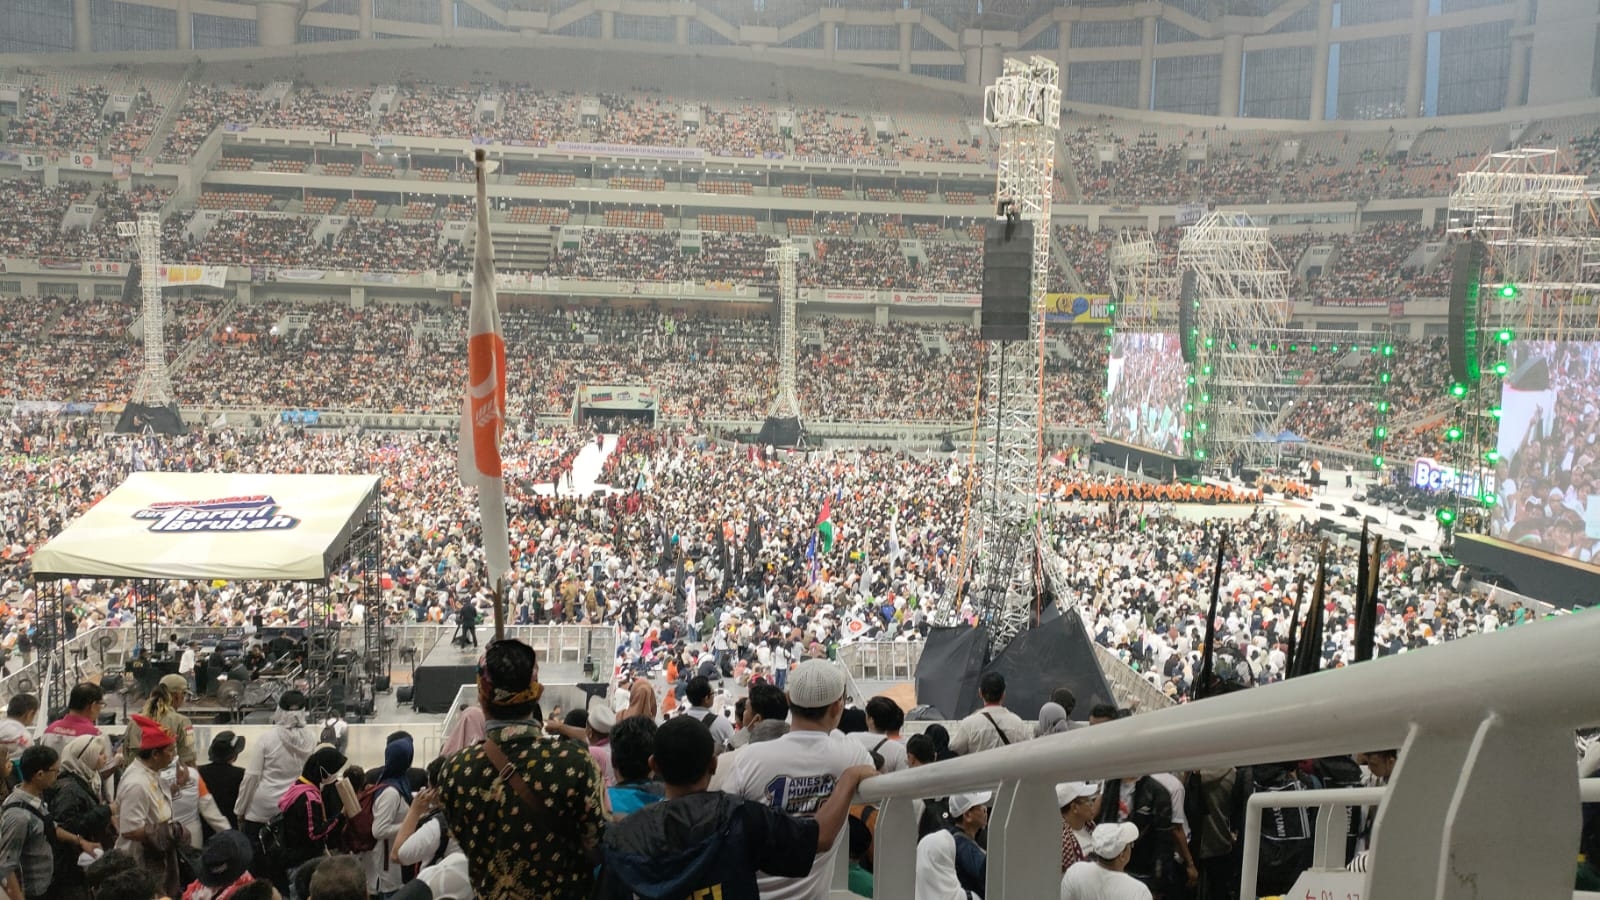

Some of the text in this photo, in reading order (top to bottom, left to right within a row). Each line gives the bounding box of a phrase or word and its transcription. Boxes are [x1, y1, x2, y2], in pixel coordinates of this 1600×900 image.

[175, 506, 273, 520] Berani
[164, 516, 292, 531] Berubah
[789, 776, 821, 787] ANIES
[767, 775, 787, 808] 1
[788, 784, 834, 797] MUHAIM
